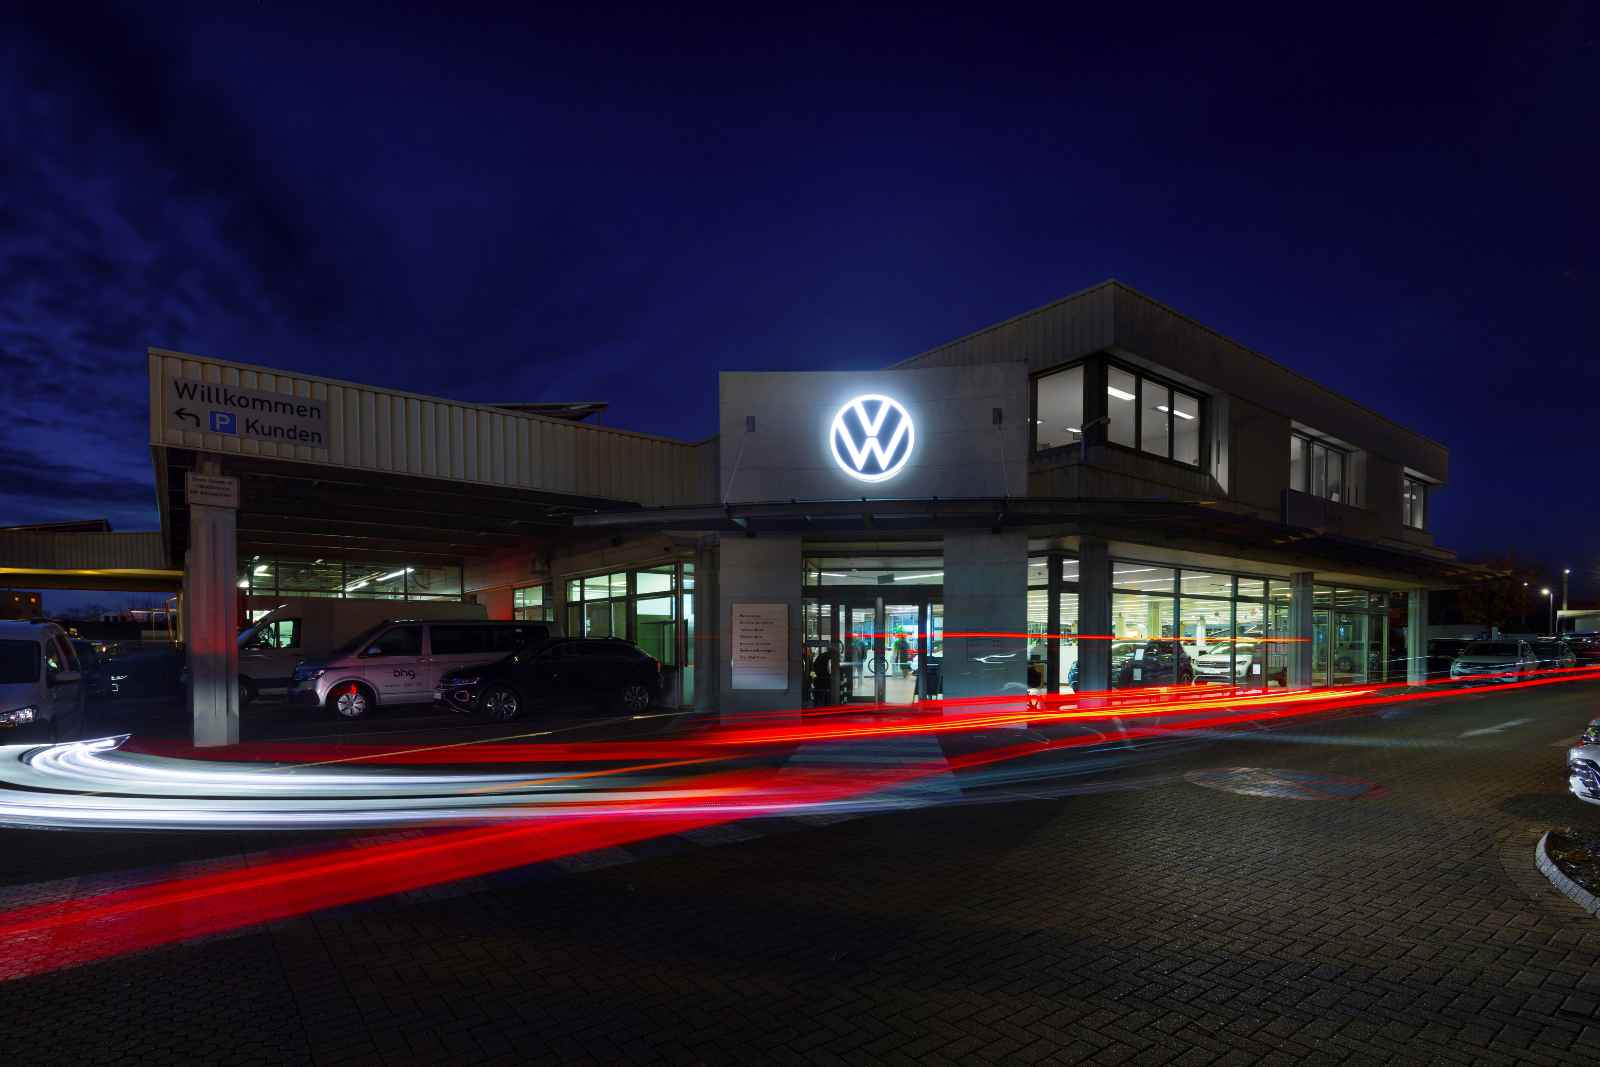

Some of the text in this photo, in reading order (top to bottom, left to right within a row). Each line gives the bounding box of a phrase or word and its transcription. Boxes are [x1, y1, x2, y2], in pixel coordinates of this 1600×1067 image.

[174, 380, 321, 419] Willkommen
[215, 413, 322, 443] P Kunden
